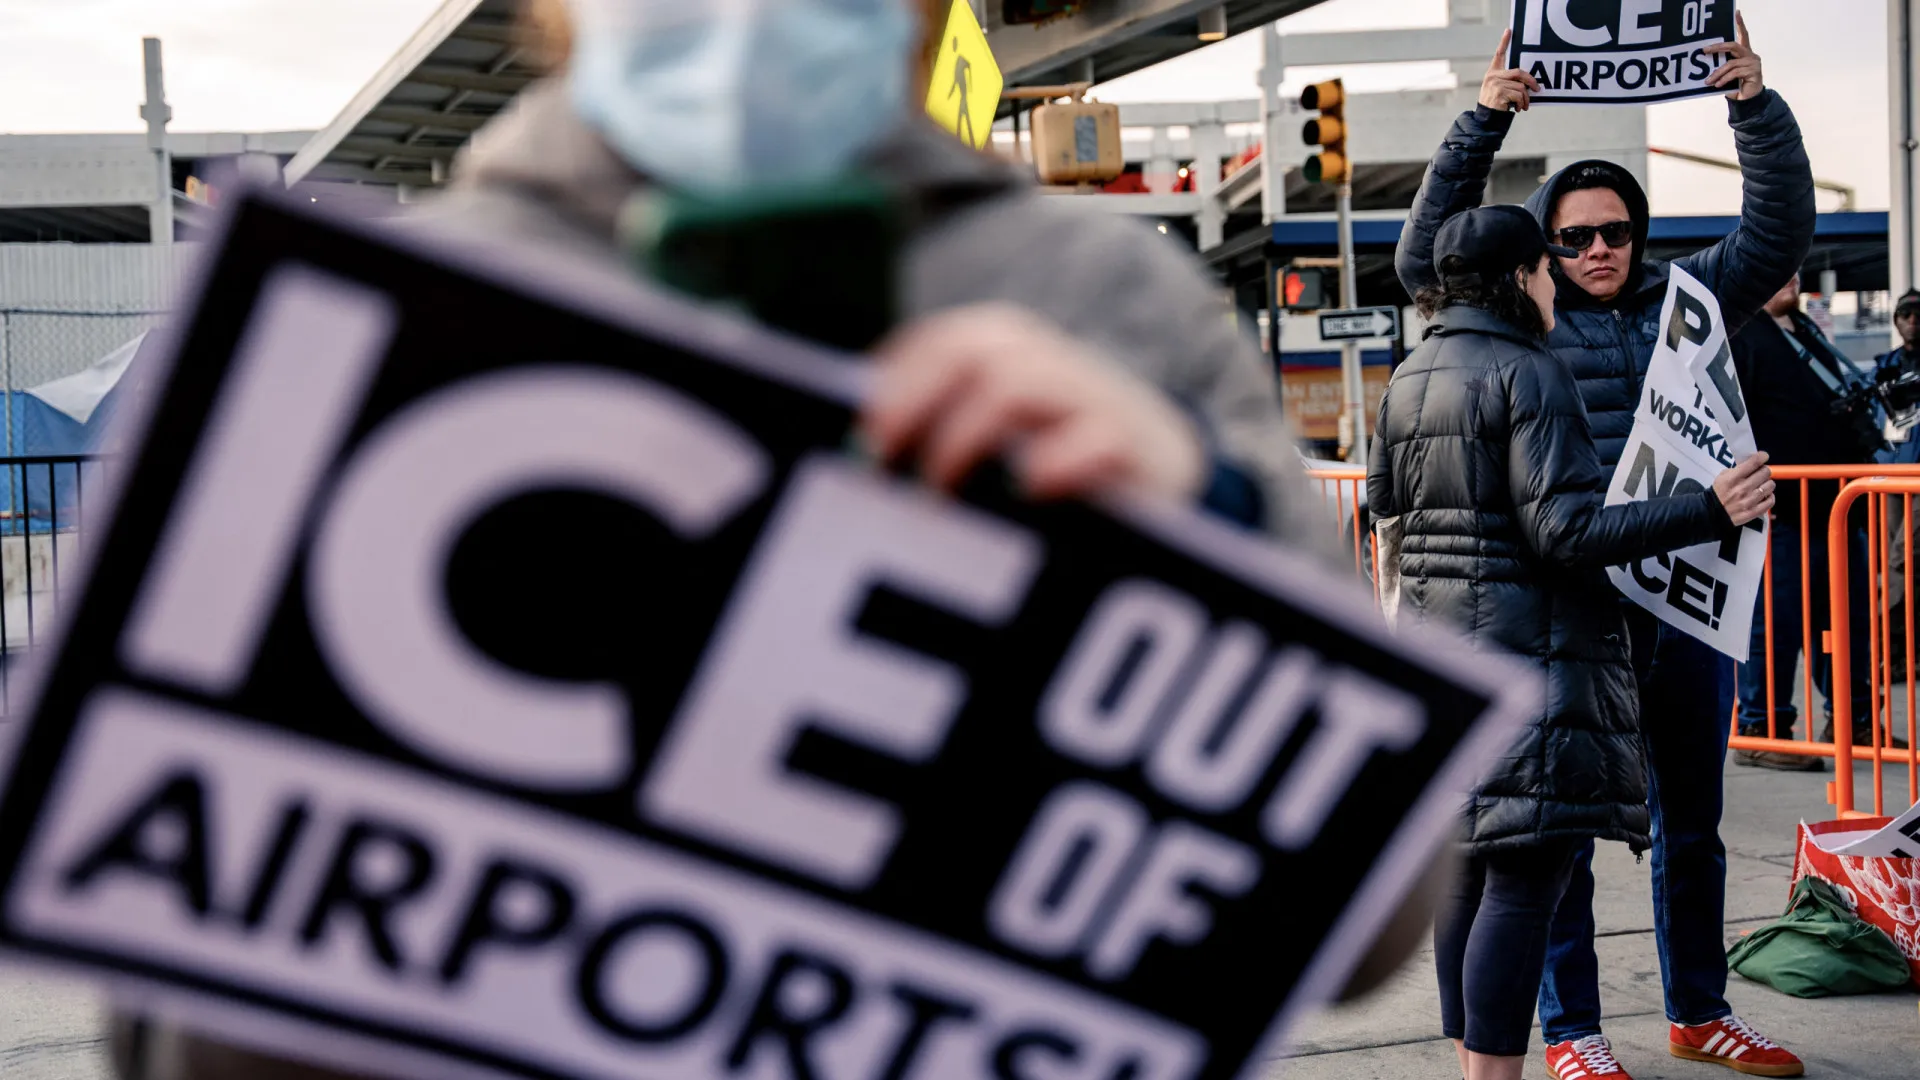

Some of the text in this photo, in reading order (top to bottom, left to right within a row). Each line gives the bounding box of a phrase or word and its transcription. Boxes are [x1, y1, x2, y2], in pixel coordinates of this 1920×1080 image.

[1682, 0, 1713, 36] OF
[1650, 388, 1737, 468] WORKE
[120, 262, 1046, 890] ICE
[1616, 550, 1728, 631] CE!
[1038, 579, 1427, 849] OUT
[64, 768, 1150, 1080] AIRPORT
[986, 781, 1262, 980] OF
